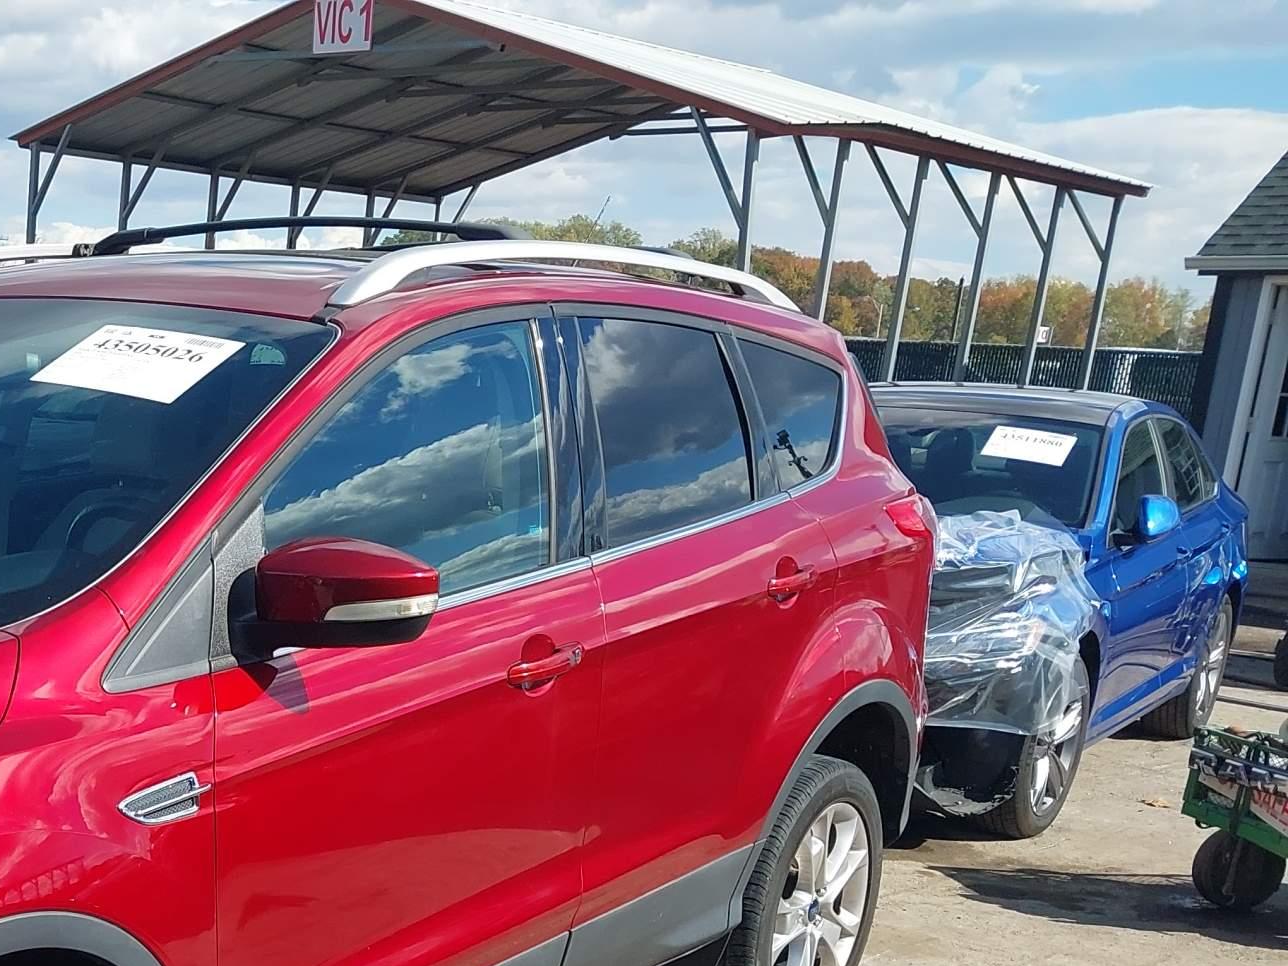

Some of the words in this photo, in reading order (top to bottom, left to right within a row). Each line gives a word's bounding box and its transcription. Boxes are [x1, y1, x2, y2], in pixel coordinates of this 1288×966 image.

[317, 0, 354, 44] VIC
[359, 0, 372, 42] 1
[93, 336, 204, 364] 43505026
